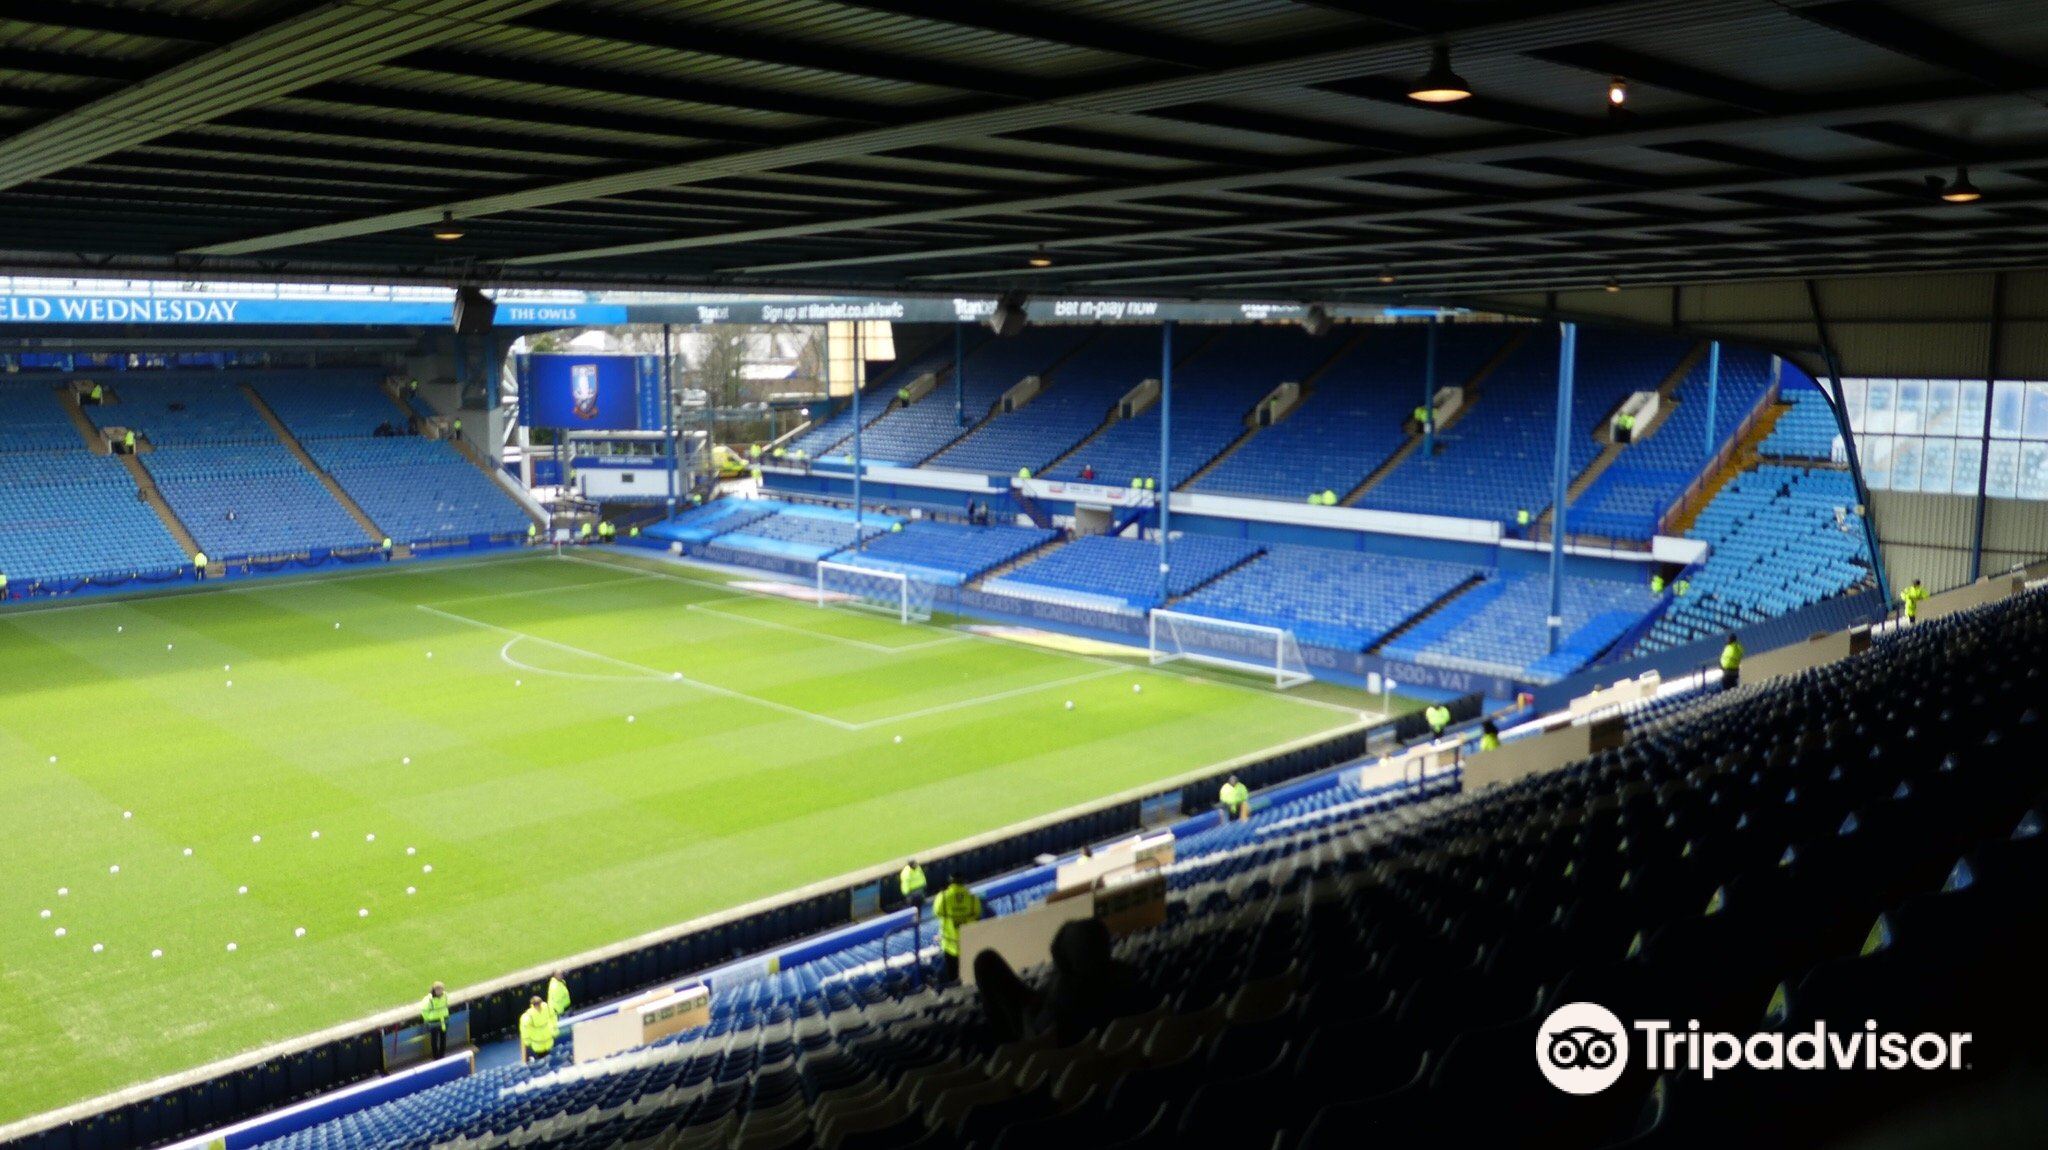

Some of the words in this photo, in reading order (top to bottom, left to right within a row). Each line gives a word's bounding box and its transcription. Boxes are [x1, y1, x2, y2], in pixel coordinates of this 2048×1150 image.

[58, 299, 238, 322] WEDNESDAY
[509, 307, 535, 320] THE
[538, 307, 577, 320] OWLS
[761, 304, 784, 323] Sign
[784, 306, 796, 323] up
[797, 306, 808, 320] at
[1054, 301, 1079, 316] Bet
[1080, 300, 1126, 319] in-play
[1127, 301, 1158, 316] now
[1438, 670, 1473, 691] VAT
